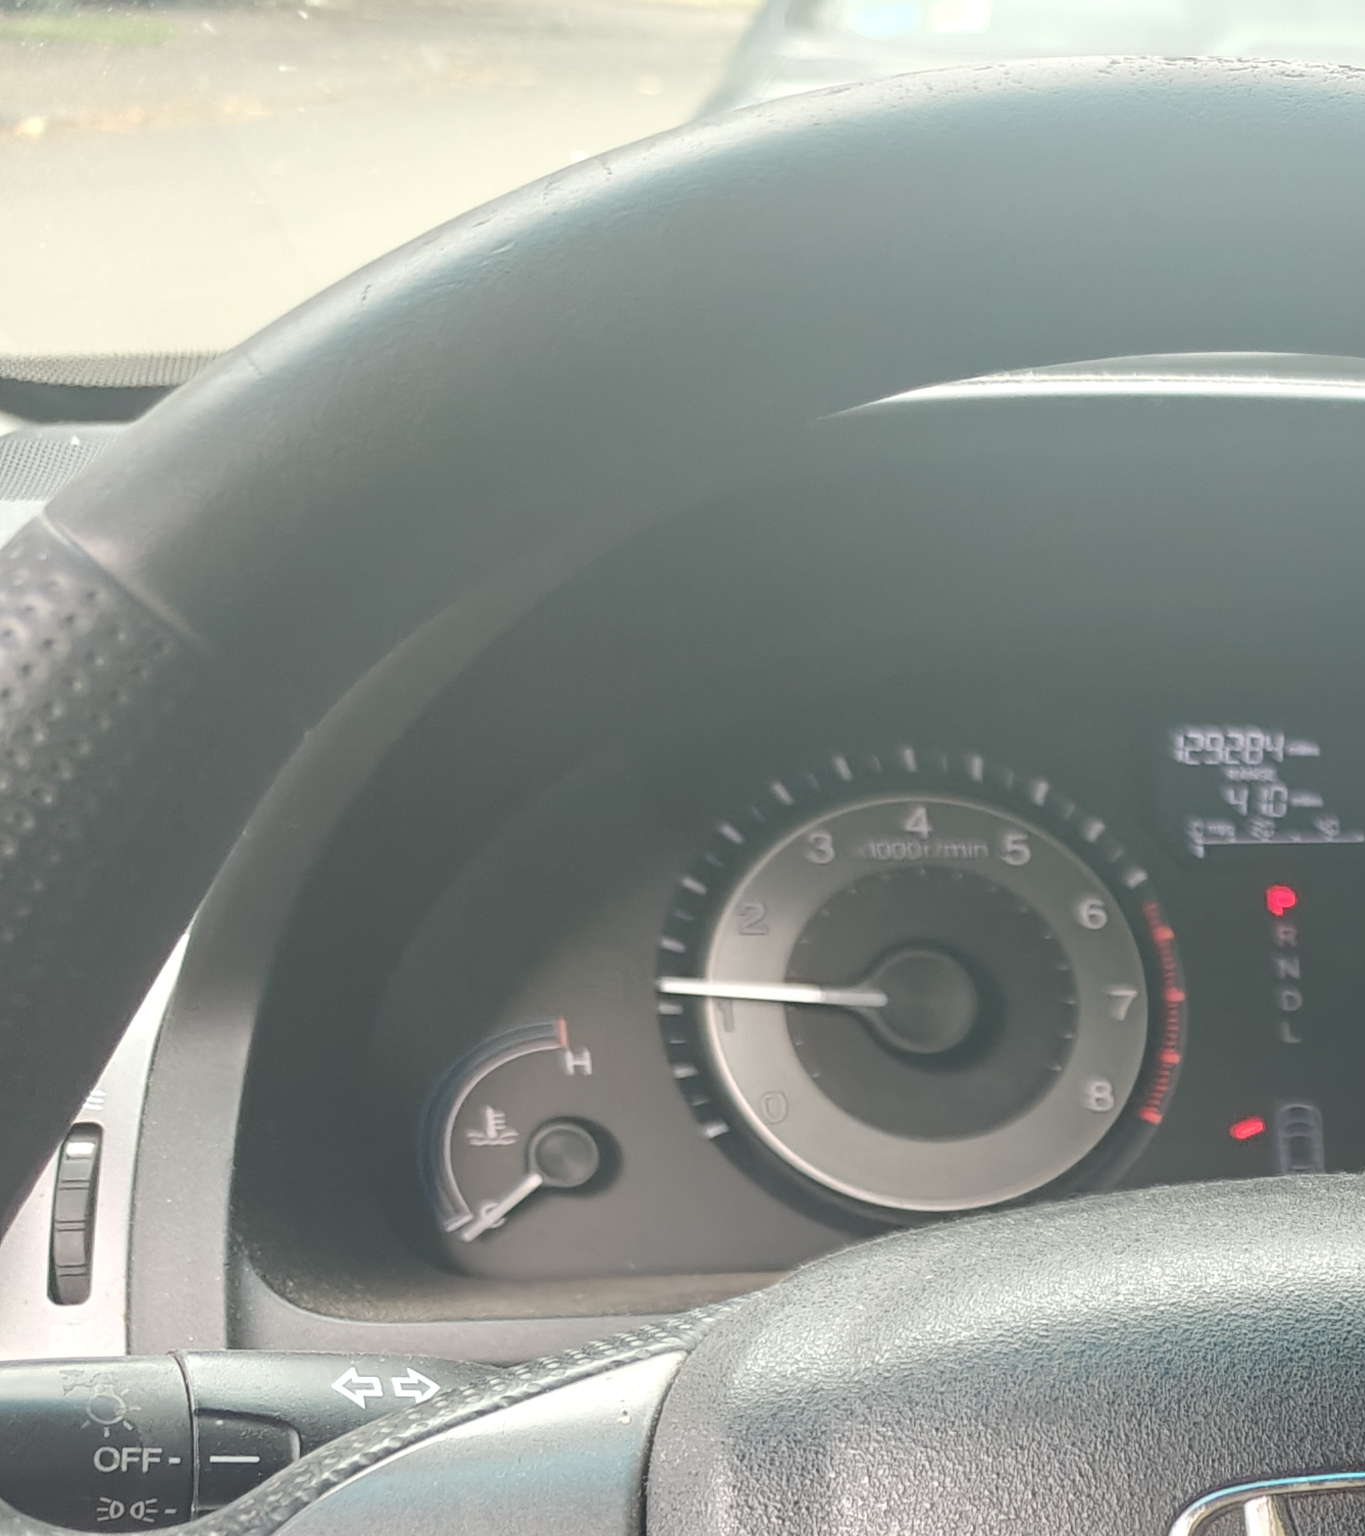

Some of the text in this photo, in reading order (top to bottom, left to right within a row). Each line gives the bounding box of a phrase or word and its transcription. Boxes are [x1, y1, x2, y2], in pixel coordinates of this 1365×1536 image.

[1173, 730, 1285, 765] 129284
[906, 808, 932, 838] 4
[809, 835, 835, 864] 3
[1001, 835, 1031, 865] 5
[1266, 884, 1297, 916] P
[738, 903, 768, 935] 2
[1078, 902, 1107, 930] 6
[1108, 990, 1137, 1020] 7
[566, 1047, 592, 1076] H
[1085, 1081, 1114, 1112] 8
[93, 1446, 163, 1473] OFF
